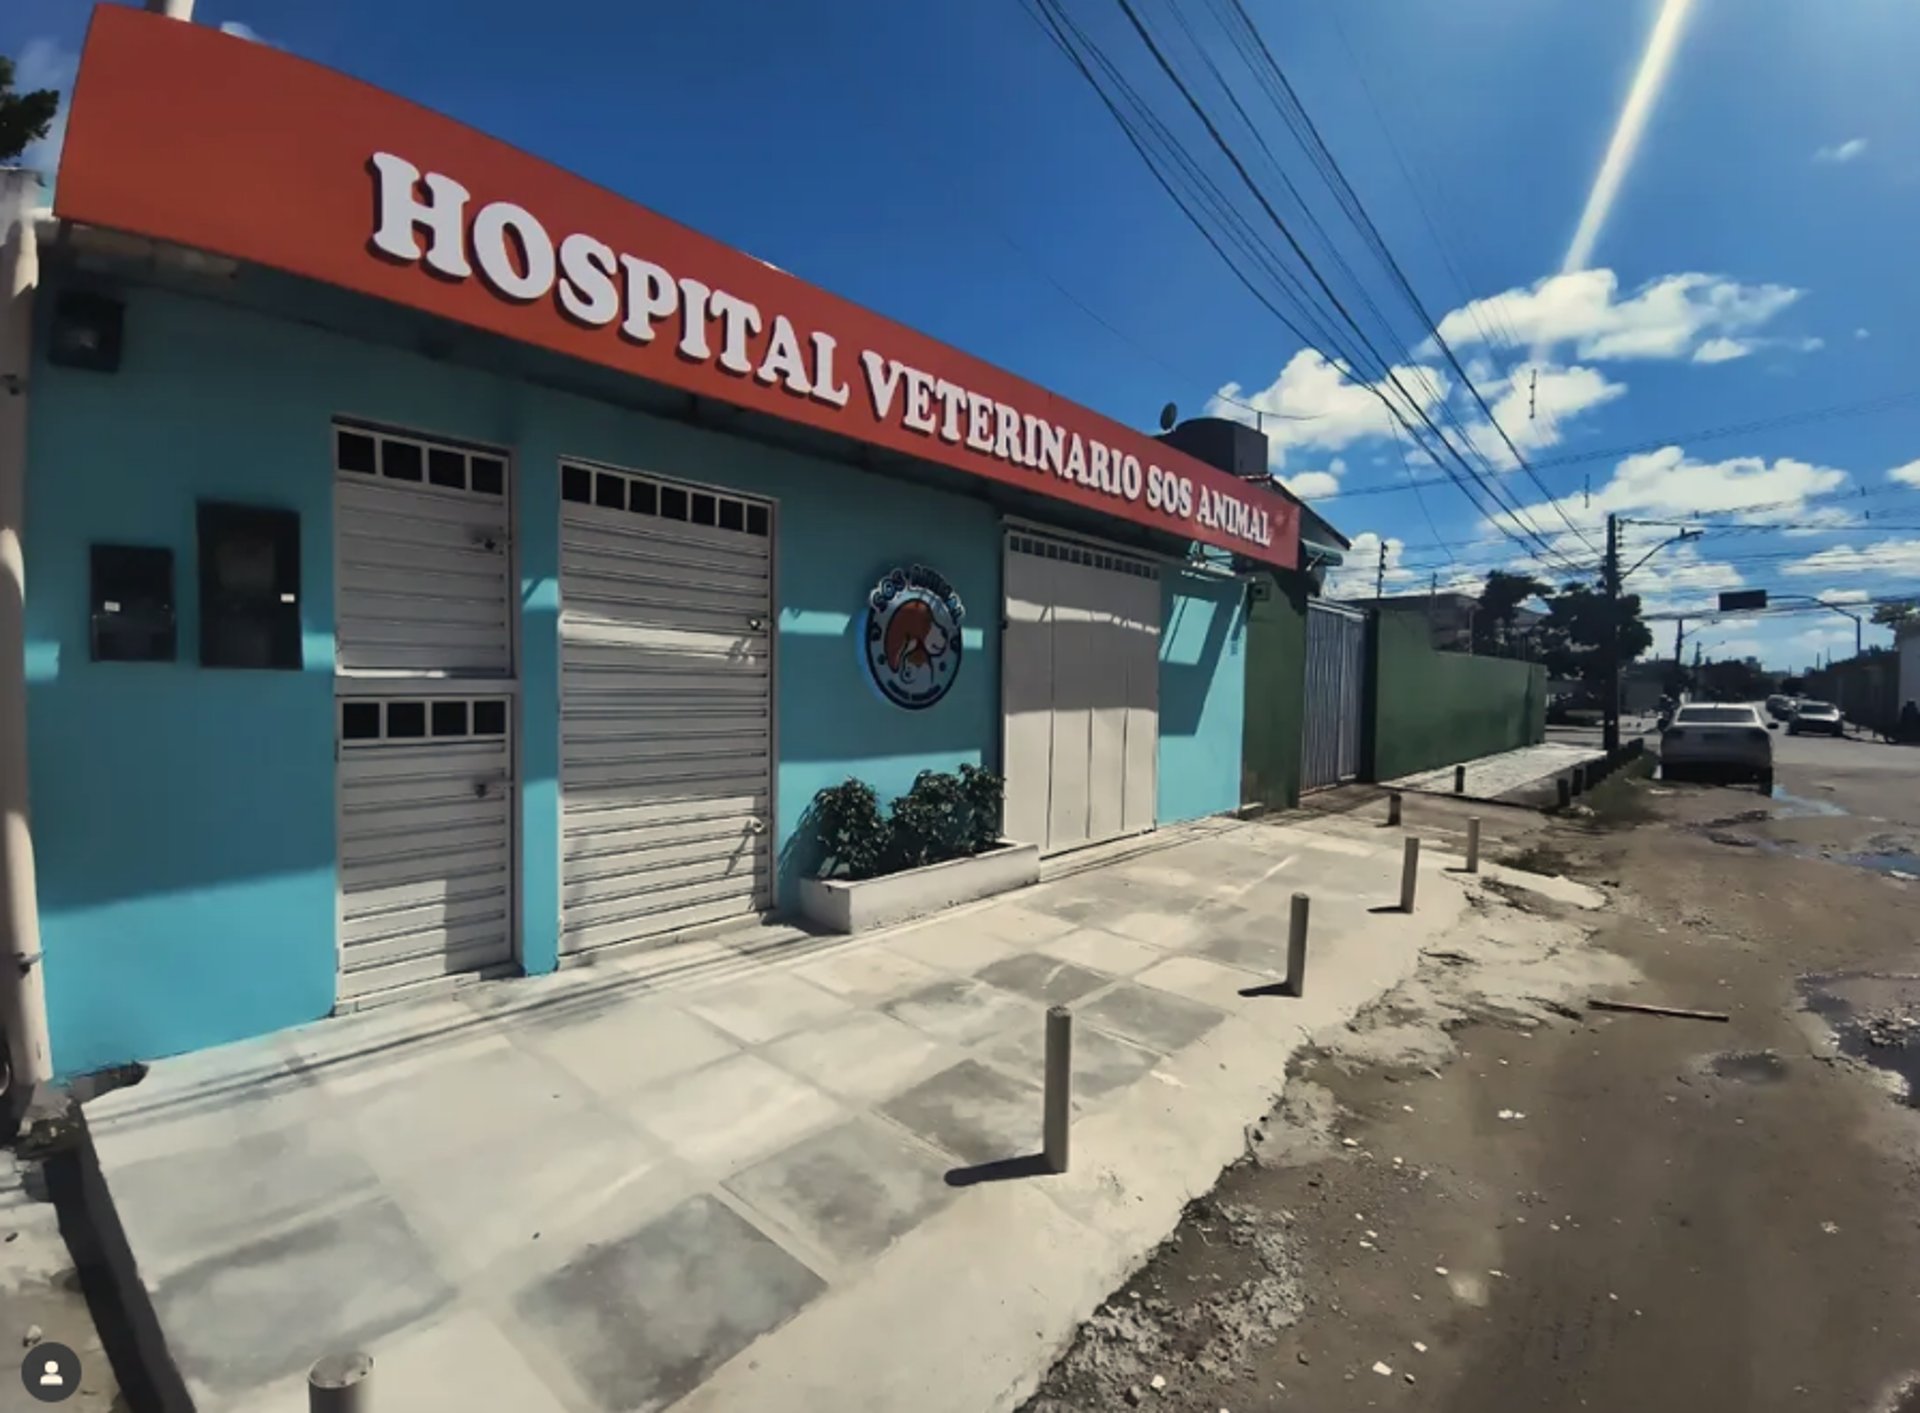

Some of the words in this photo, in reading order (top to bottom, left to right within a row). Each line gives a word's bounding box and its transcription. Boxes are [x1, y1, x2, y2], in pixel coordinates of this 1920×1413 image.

[372, 151, 849, 407] HOSPITAL
[862, 350, 1142, 501] VETERINARIO
[1146, 464, 1193, 518] SOS
[1196, 485, 1273, 547] ANIMAL
